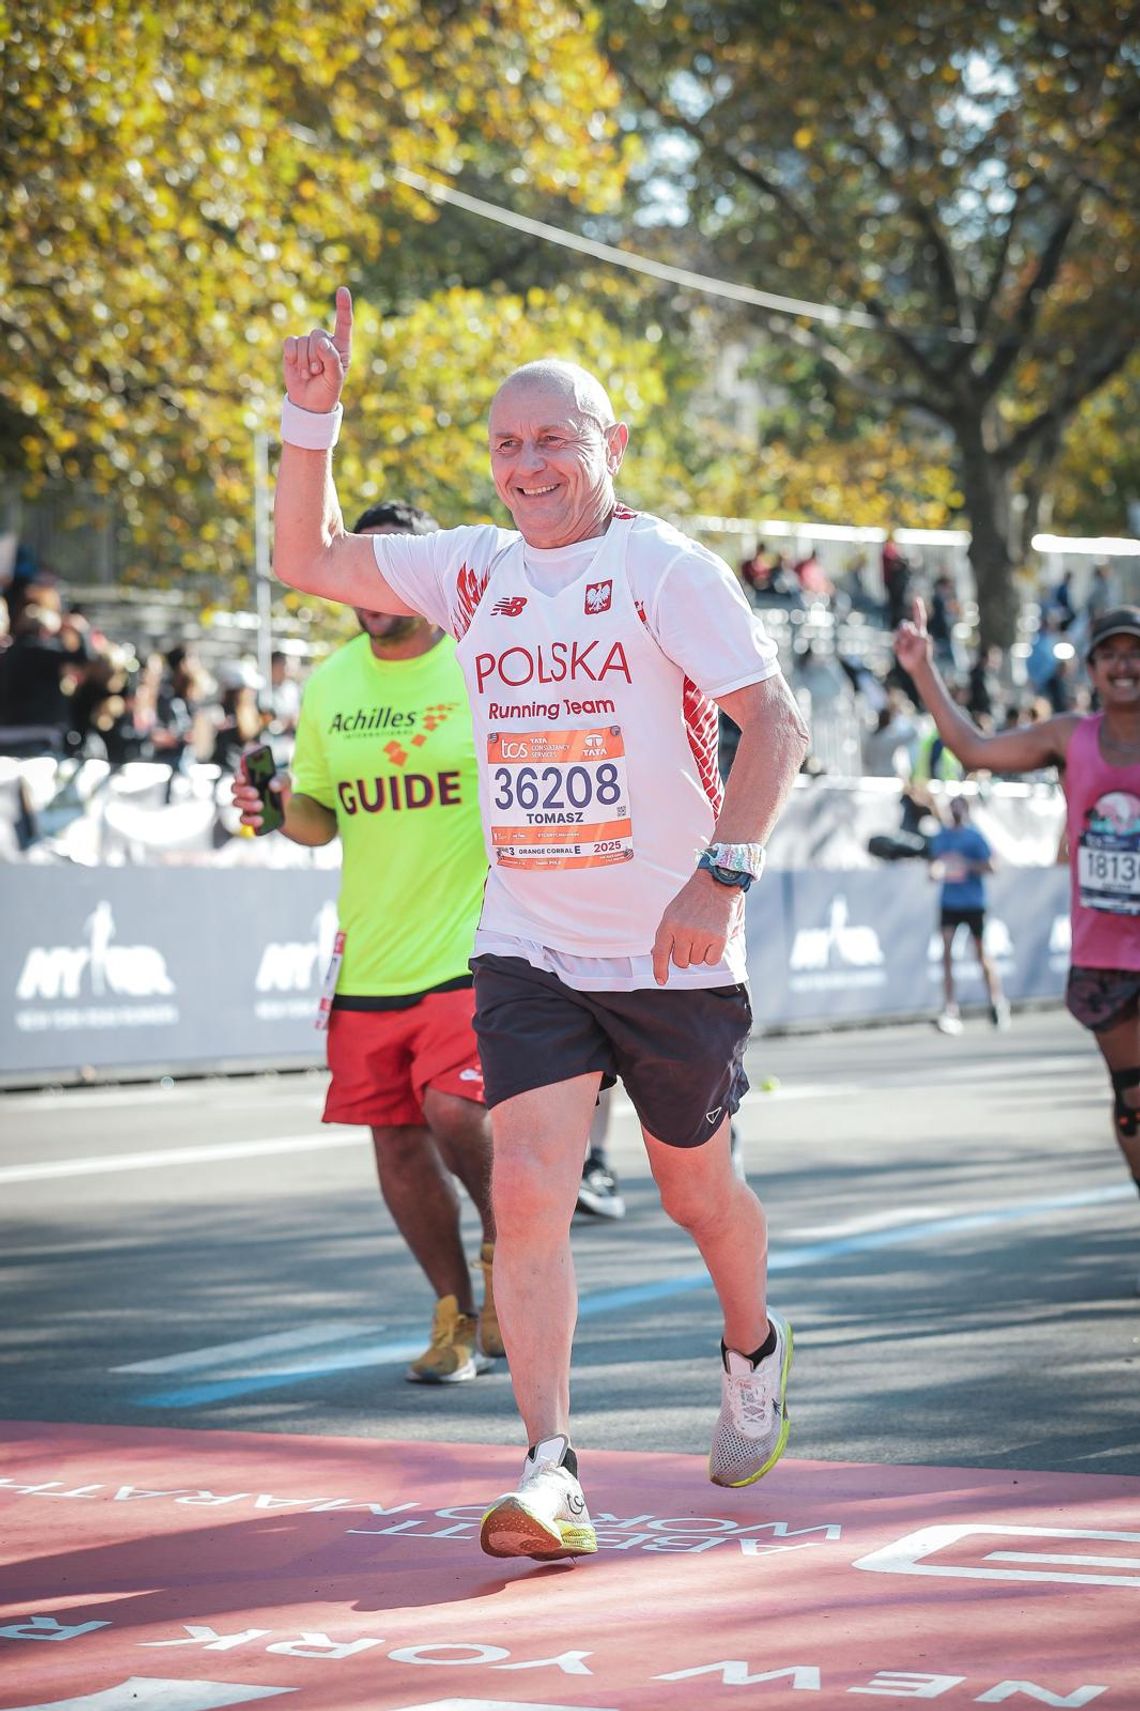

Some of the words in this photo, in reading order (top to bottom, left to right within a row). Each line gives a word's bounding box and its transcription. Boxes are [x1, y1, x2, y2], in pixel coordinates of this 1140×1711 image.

[475, 640, 632, 694] POLSKA
[328, 707, 417, 734] Achilles
[488, 701, 560, 720] Running
[563, 699, 615, 714] Team
[582, 748, 607, 756] TATA
[337, 771, 462, 815] GUIDE
[494, 763, 621, 810] 36208
[526, 812, 584, 824] TOMASZ
[574, 846, 581, 855] E
[593, 841, 622, 853] 2025
[1088, 852, 1140, 881] 1813
[346, 1519, 826, 1556] ABBTT
[434, 1505, 841, 1541] WORD
[135, 1625, 594, 1675] YORK
[650, 1660, 1110, 1708] NEW
